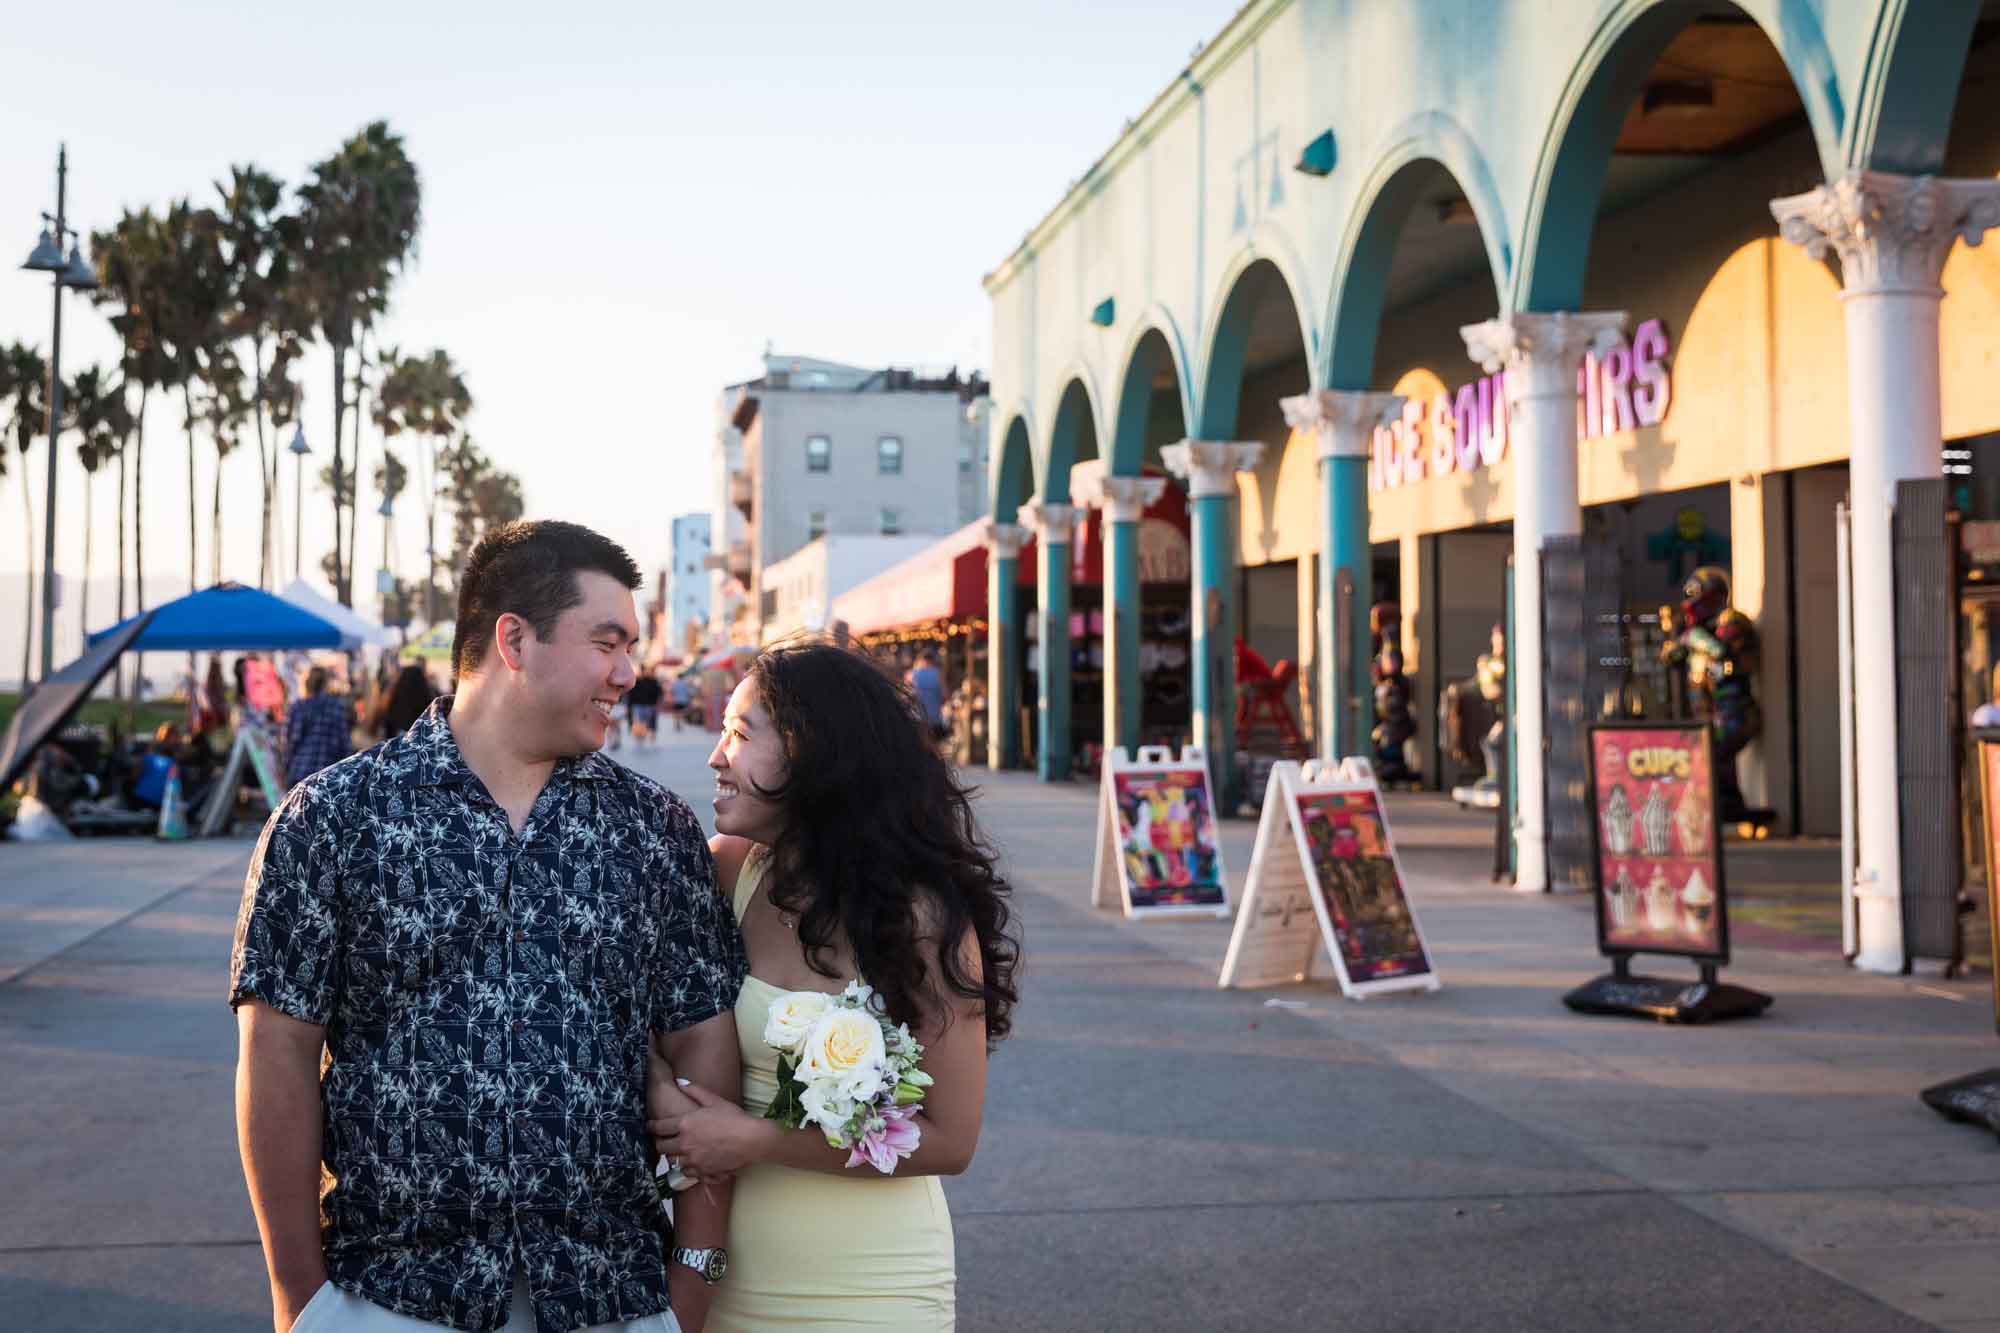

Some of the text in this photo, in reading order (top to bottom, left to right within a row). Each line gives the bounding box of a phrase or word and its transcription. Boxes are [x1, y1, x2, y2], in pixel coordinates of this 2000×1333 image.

[1373, 318, 1671, 492] ICE SOUIRS
[1627, 746, 1690, 779] CUPS
